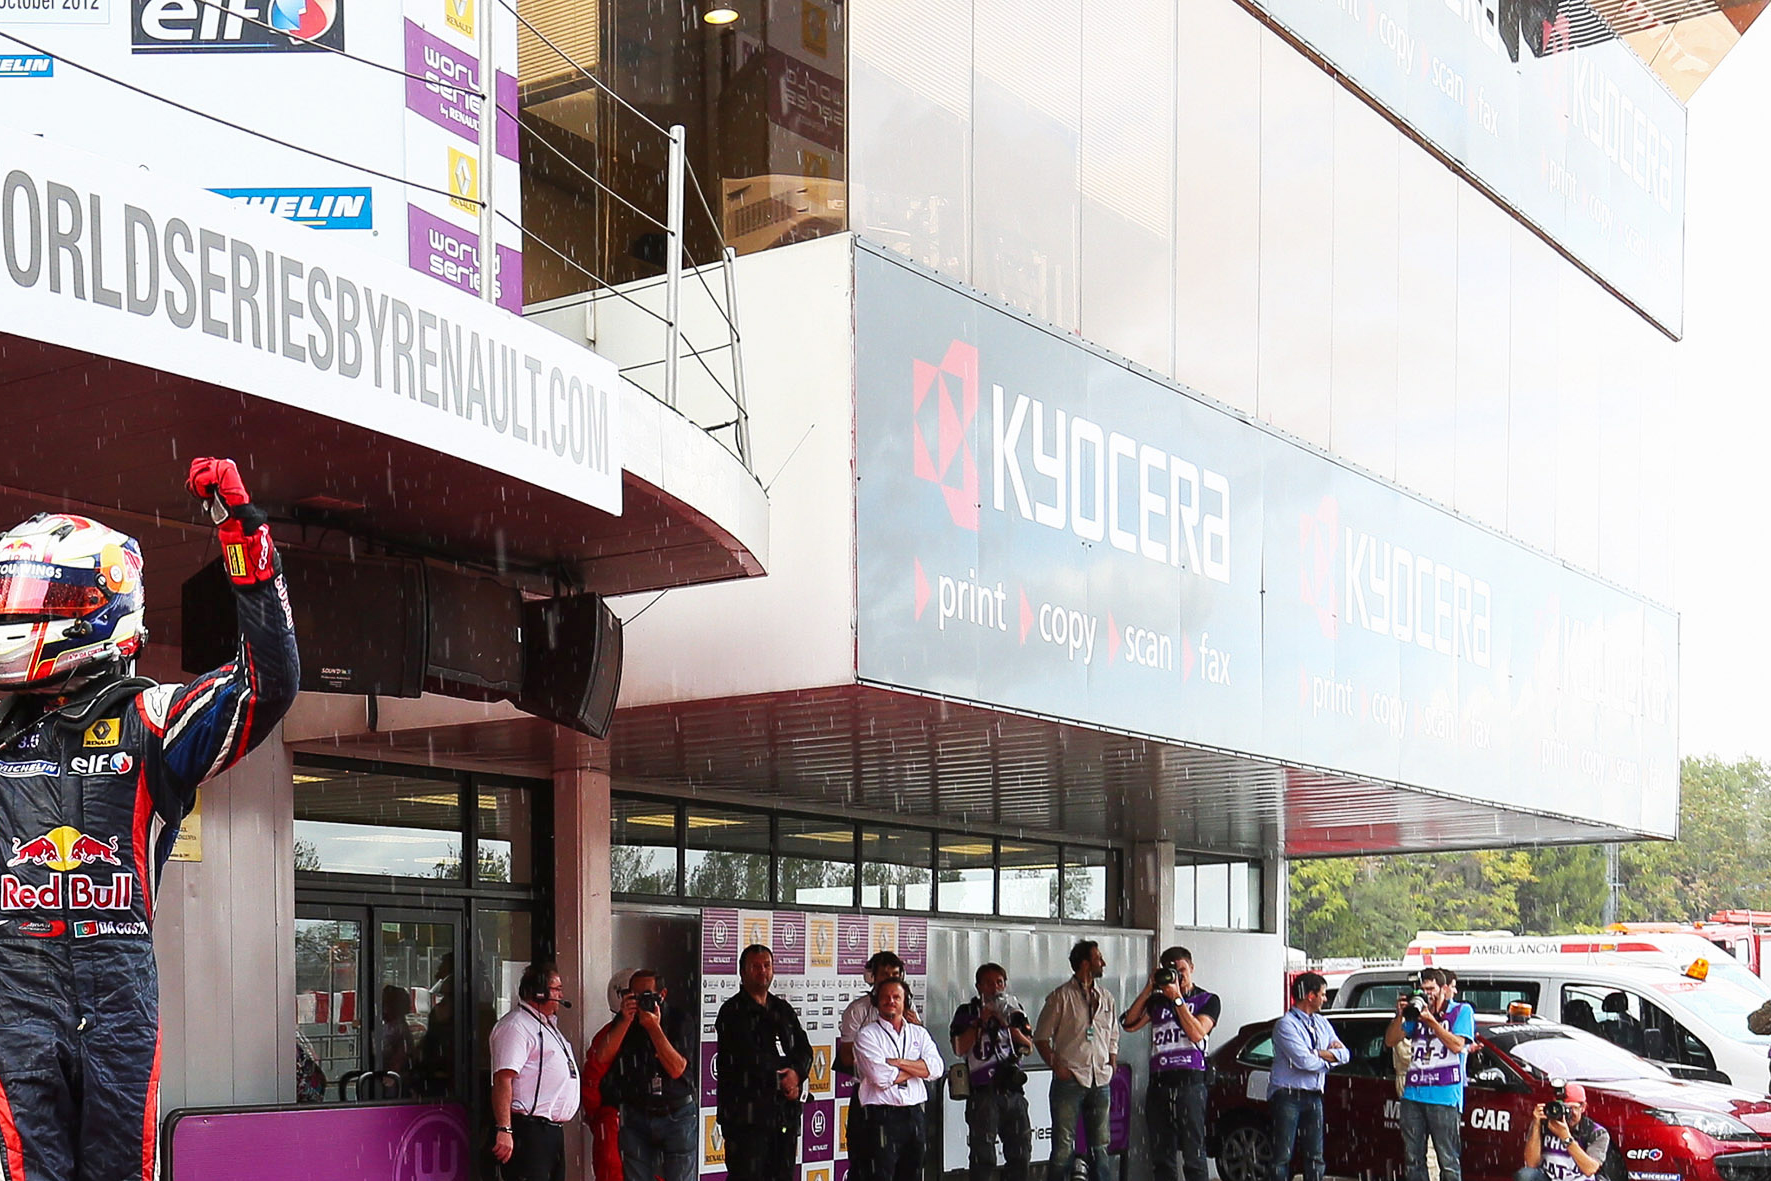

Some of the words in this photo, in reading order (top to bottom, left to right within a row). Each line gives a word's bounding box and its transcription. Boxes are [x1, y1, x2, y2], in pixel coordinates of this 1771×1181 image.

[1377, 11, 1416, 76] copy
[1431, 57, 1465, 107] scan
[1475, 85, 1501, 138] fax
[1573, 46, 1675, 214] KYOCERA
[1547, 158, 1578, 204] print
[1587, 190, 1615, 236] copy
[991, 383, 1231, 584] KYOCERA
[16, 563, 62, 579] WINGS
[1344, 526, 1493, 670] KYOCERA
[937, 571, 1008, 632] print
[1039, 603, 1098, 668] copy
[1124, 625, 1173, 673] scan
[1198, 630, 1232, 688] fax
[1311, 668, 1355, 721] print
[1370, 689, 1409, 741] copy
[1424, 709, 1456, 751] scan
[1468, 712, 1493, 752] fax
[70, 753, 110, 774] elf
[85, 738, 116, 746] RENAULT
[1541, 736, 1570, 772] print
[1582, 747, 1606, 786] copy
[1, 874, 62, 910] Red
[69, 874, 132, 910] Bull
[99, 922, 116, 934] DA
[116, 921, 149, 935] COSTA
[1470, 1108, 1511, 1132] CAR
[1627, 1149, 1650, 1160] elf
[1640, 1173, 1679, 1181] MICHELIN
